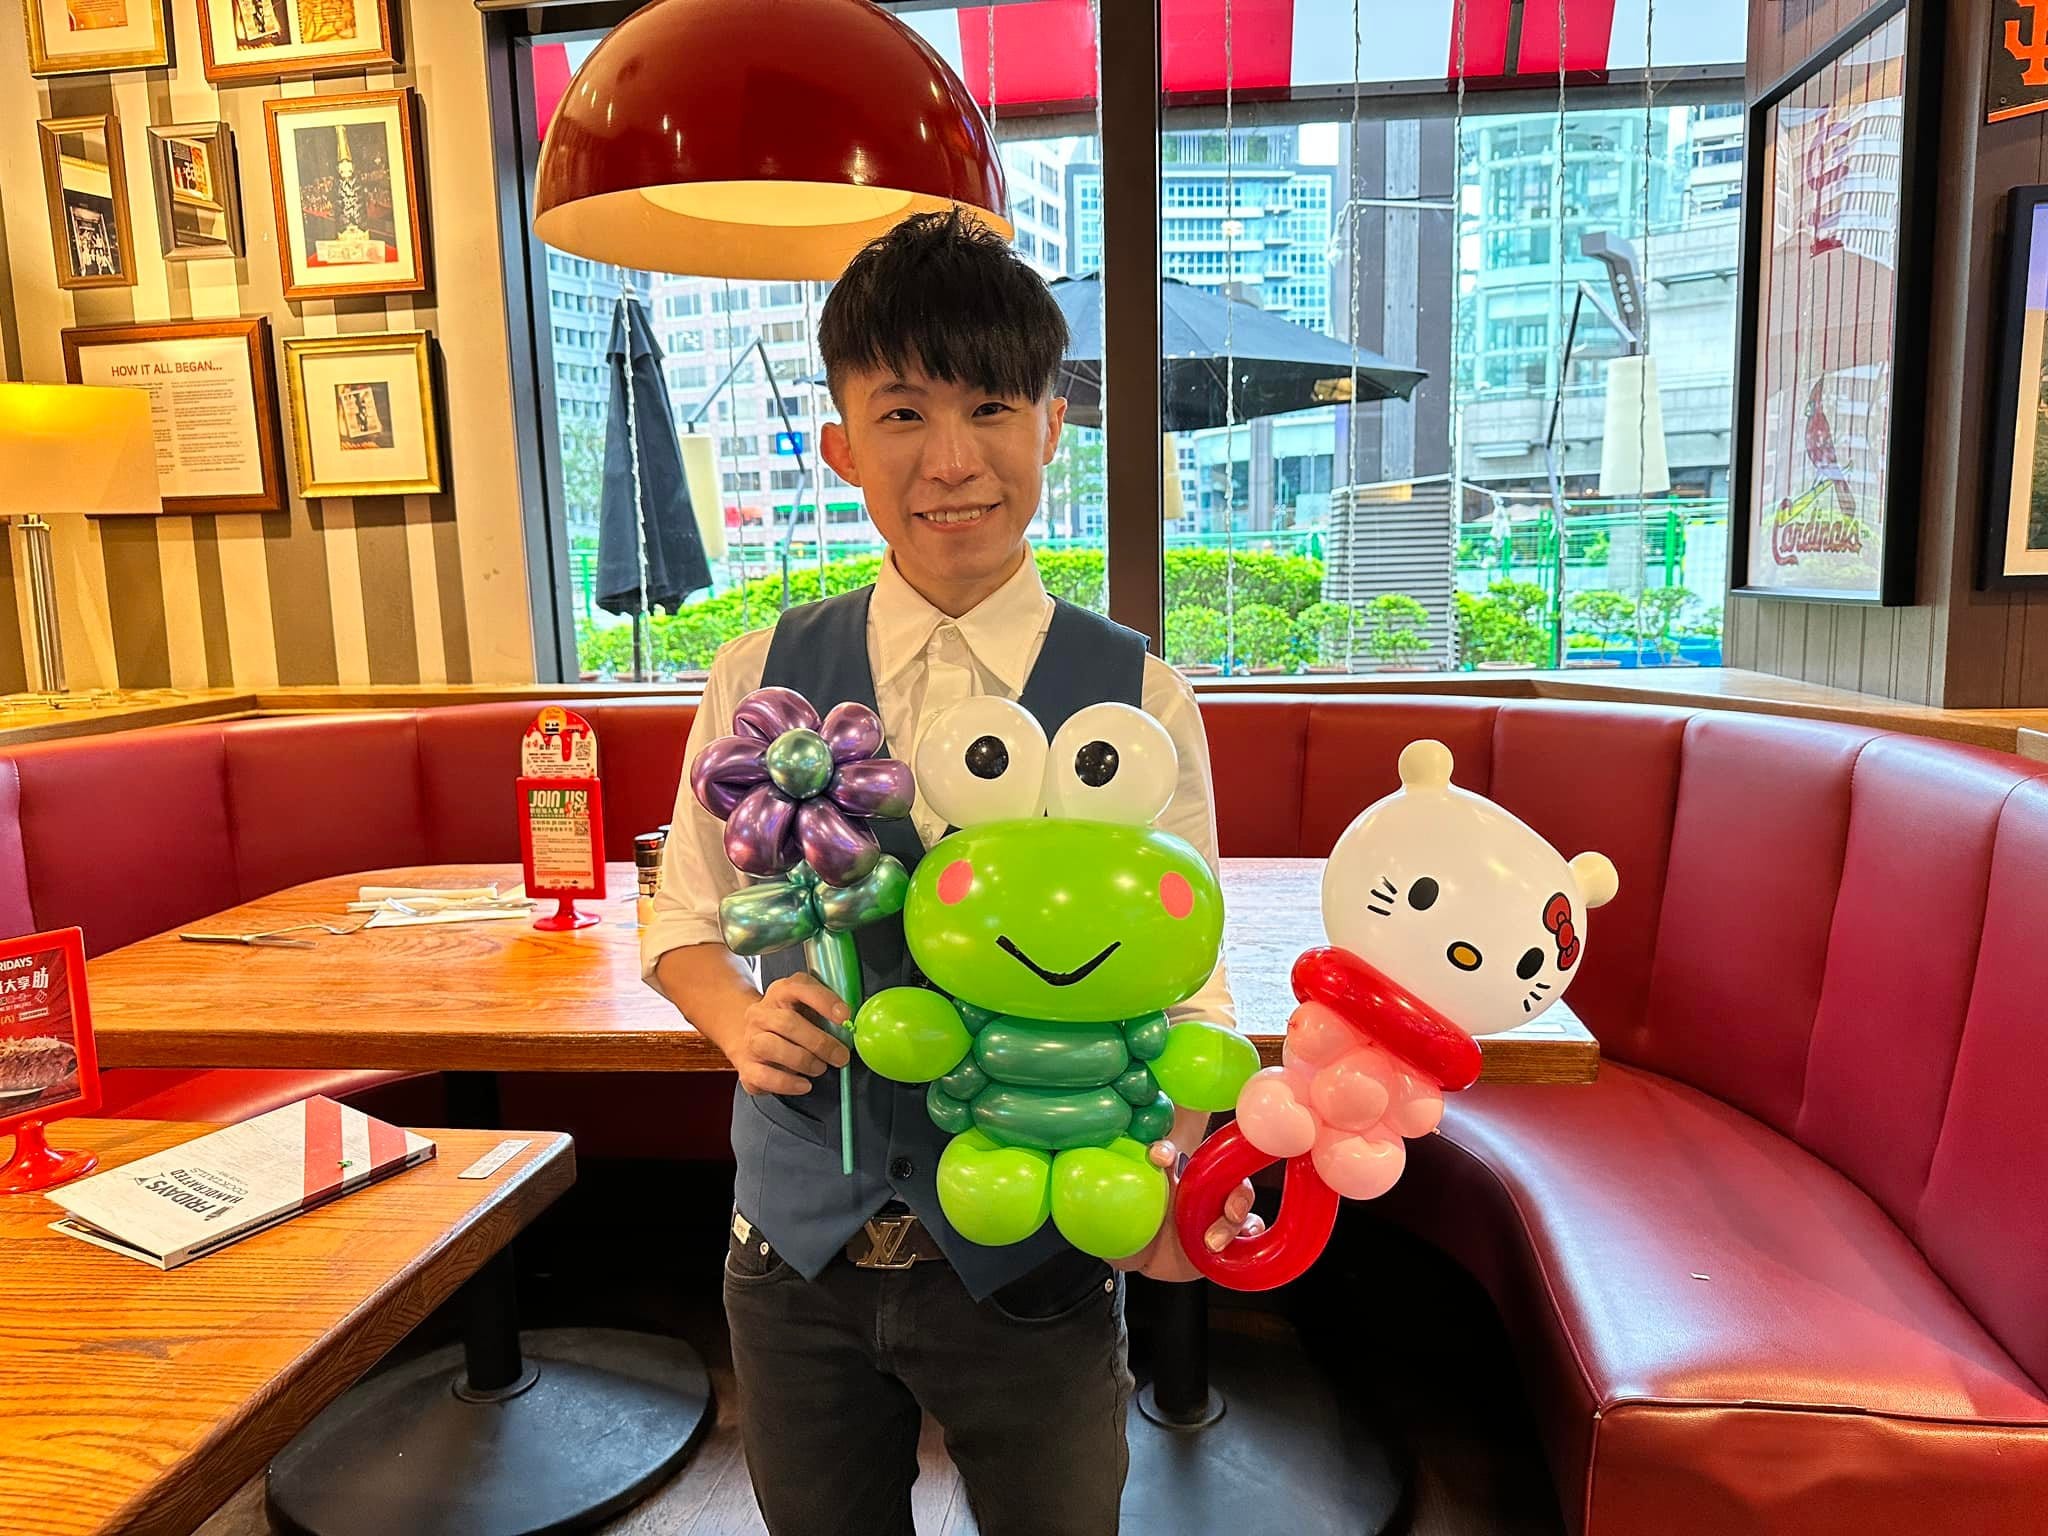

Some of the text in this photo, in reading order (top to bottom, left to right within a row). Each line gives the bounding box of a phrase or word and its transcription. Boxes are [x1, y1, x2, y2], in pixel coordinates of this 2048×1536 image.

[111, 359, 222, 377] HOW IT ALL BEGAN...
[1772, 499, 1862, 565] Cardinals
[529, 790, 561, 808] JOIN
[0, 956, 33, 972] RIDAYS
[170, 1169, 244, 1204] HANDCRAFTED
[189, 1167, 249, 1195] COCKTAILS
[145, 1180, 216, 1213] FRIDAYS
